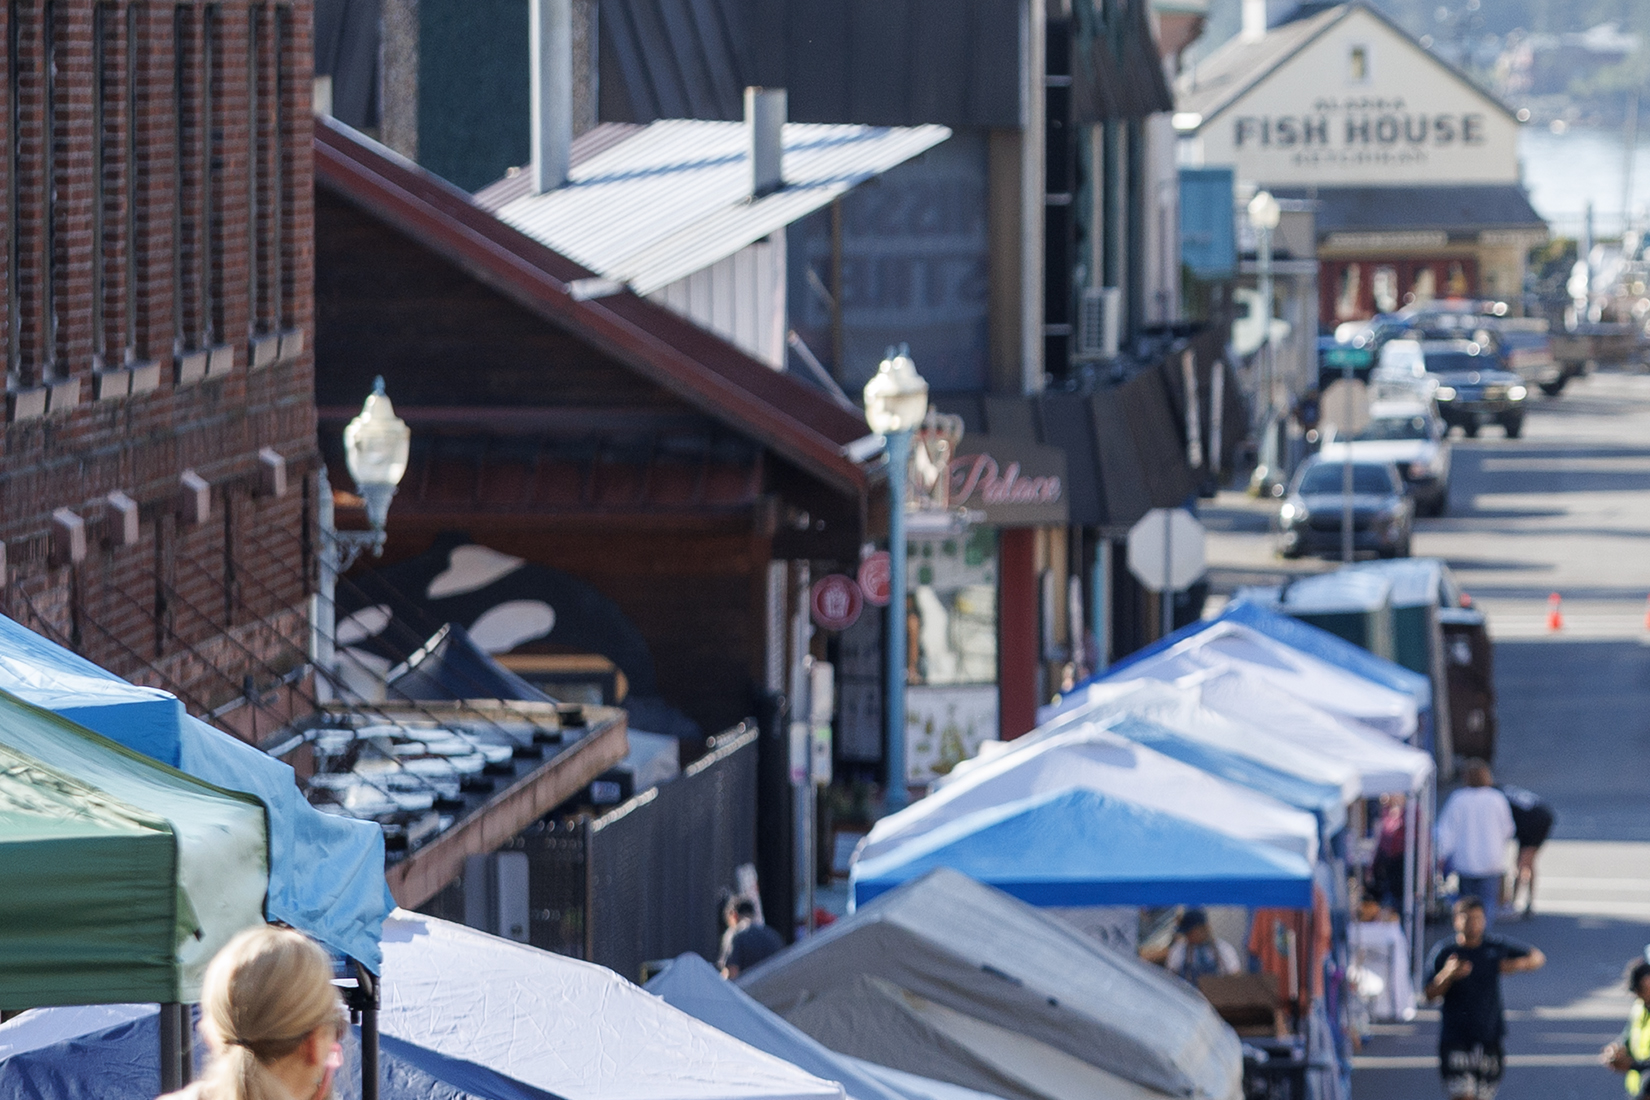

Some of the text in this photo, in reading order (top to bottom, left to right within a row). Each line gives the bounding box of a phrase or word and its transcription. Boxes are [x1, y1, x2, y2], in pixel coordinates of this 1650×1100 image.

[1234, 113, 1486, 147] FISH HOUSE
[949, 453, 1062, 505] Palace
